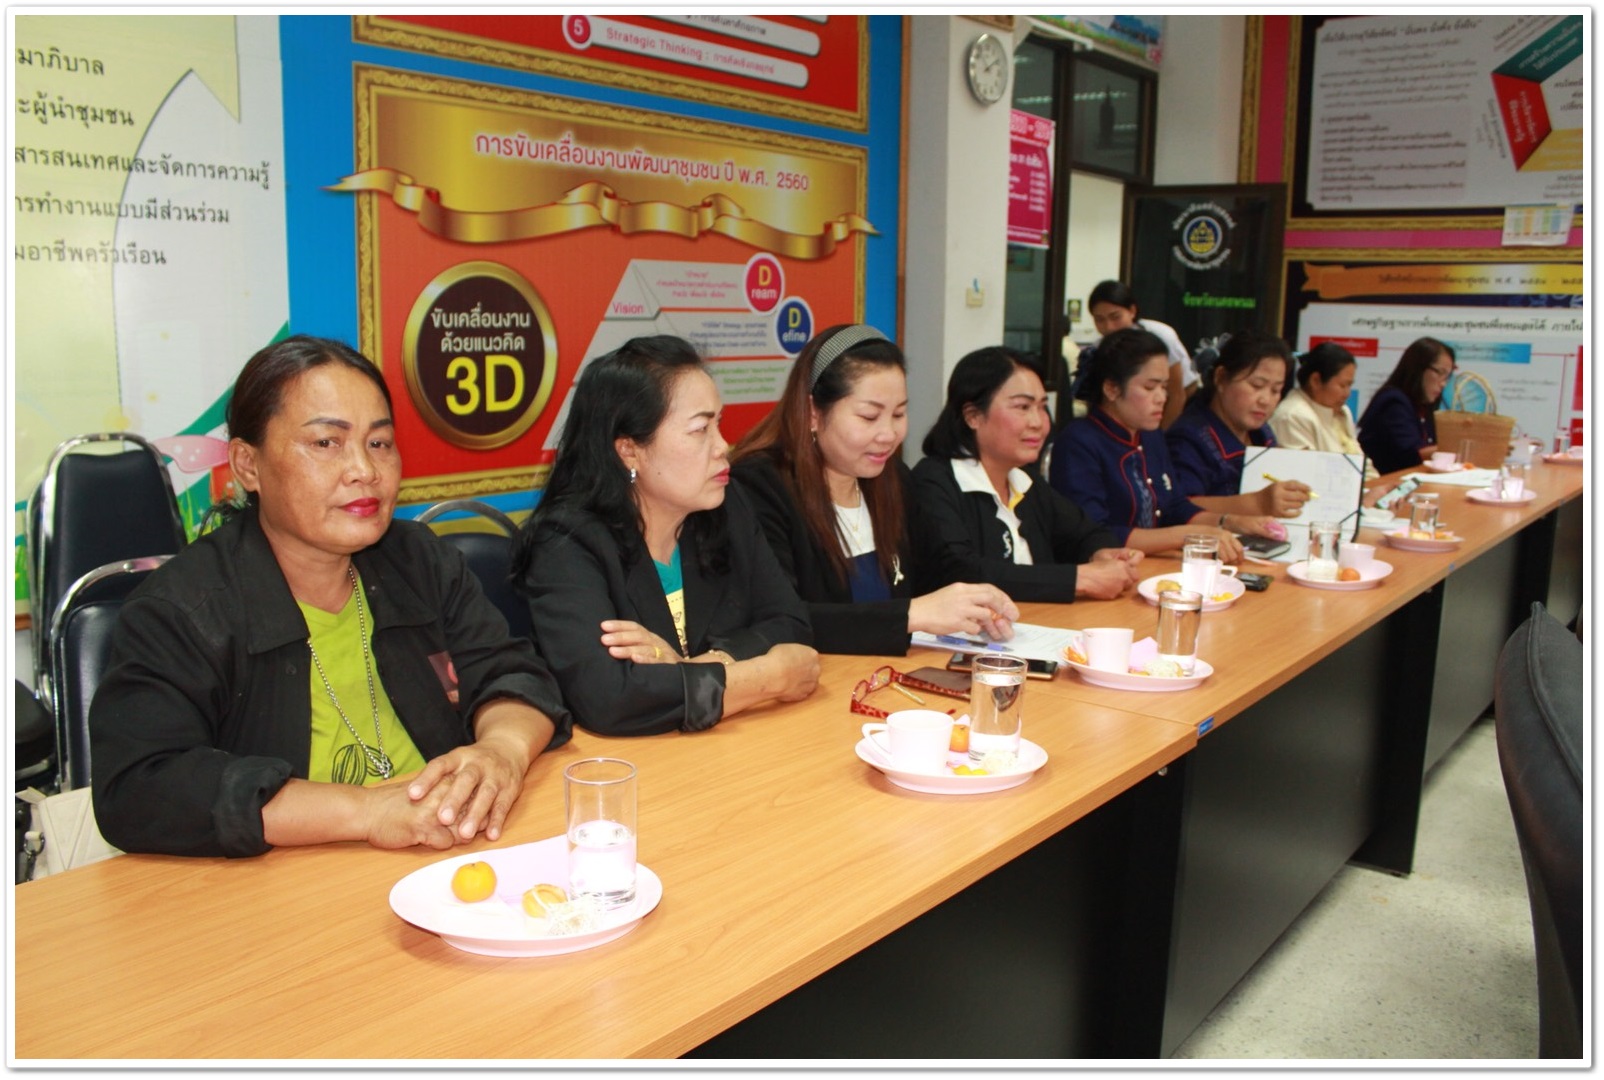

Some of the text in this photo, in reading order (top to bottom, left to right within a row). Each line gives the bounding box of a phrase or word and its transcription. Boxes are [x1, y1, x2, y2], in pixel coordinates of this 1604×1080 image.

[573, 18, 584, 36] 5
[606, 26, 657, 49] Strategic
[660, 37, 703, 62] Thinking
[475, 132, 810, 192] การขับเคลื่อนงานพัฒนาชุมชน ปี พ.ศ. 2560
[758, 265, 773, 288] D
[751, 288, 778, 300] ream
[431, 301, 531, 329] ขับเคลื่อนงาน
[612, 302, 645, 316] Vision
[788, 307, 801, 329] D
[440, 331, 526, 353] ด้วยแนวคิด
[781, 330, 806, 343] efine
[445, 353, 526, 417] 3D
